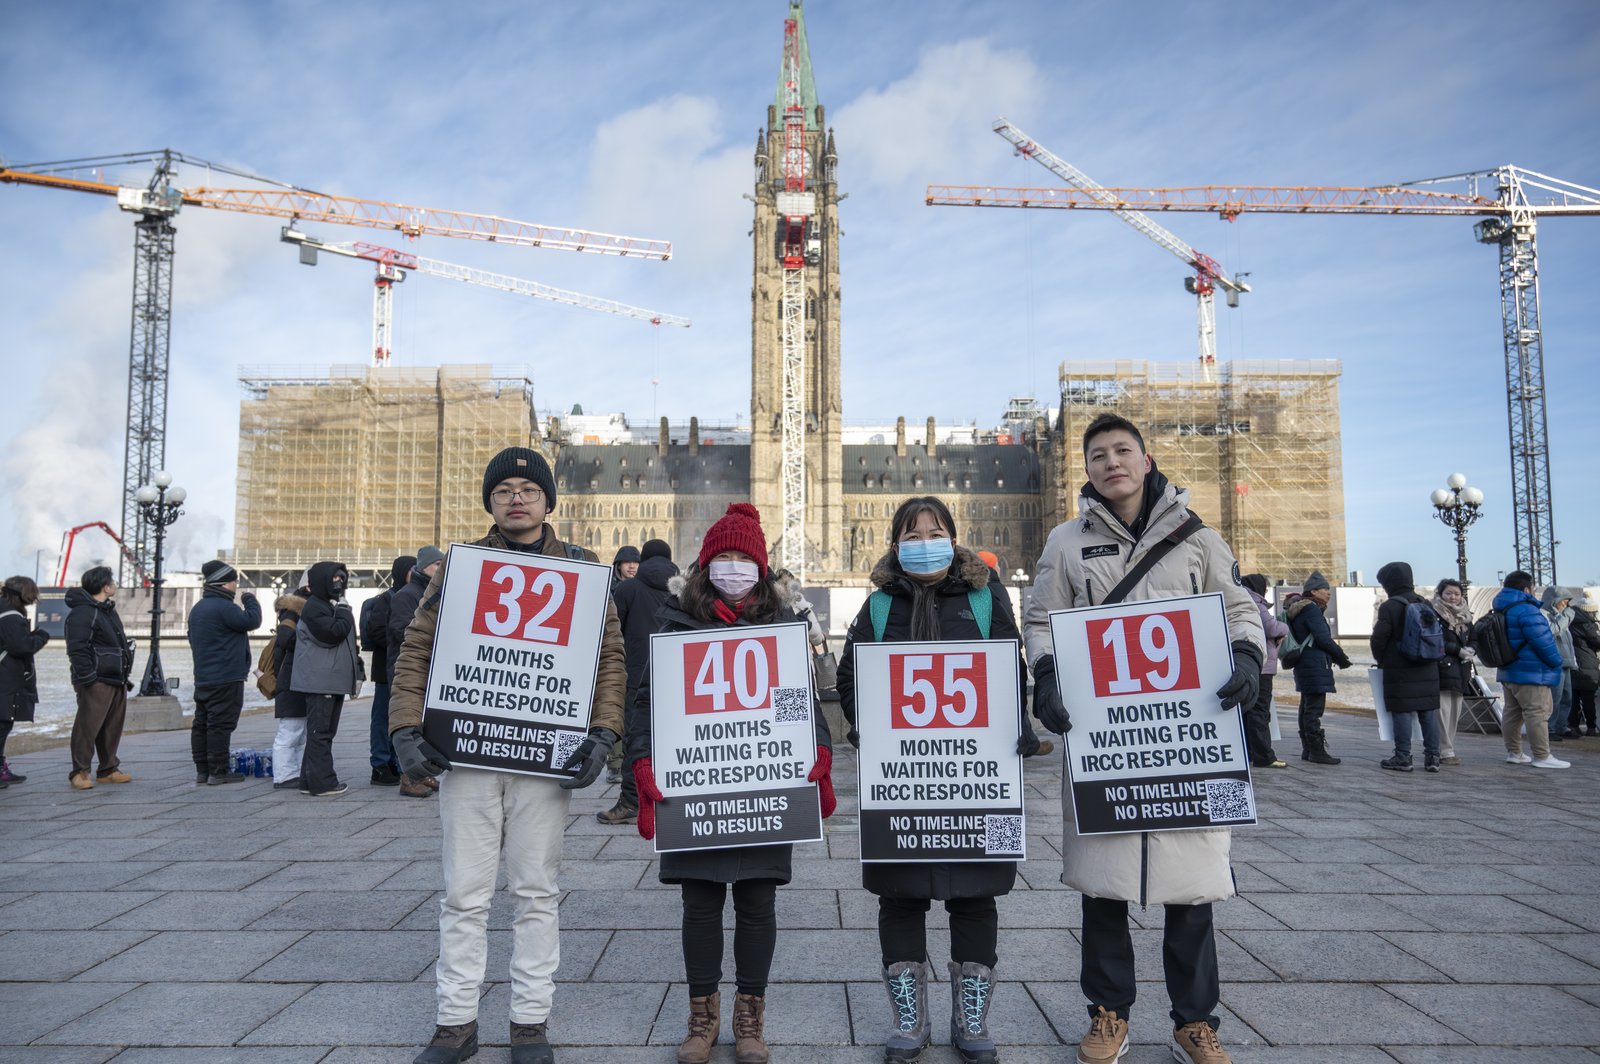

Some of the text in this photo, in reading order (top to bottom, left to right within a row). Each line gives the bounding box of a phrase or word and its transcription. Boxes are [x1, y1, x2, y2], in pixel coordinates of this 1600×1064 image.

[485, 565, 566, 642] 32
[477, 645, 555, 670] MONTHS
[1102, 614, 1180, 693] 19
[455, 664, 571, 695] WAITING FOR
[694, 639, 769, 711] 40
[439, 685, 579, 718] IRCC RESPONSE
[901, 654, 977, 726] 55
[1108, 701, 1191, 724] MONTHS
[453, 719, 555, 744] NO TIMELINES
[695, 720, 771, 741] MONTHS
[1089, 722, 1218, 748] WAITING FOR
[456, 738, 546, 762] NO RESULTS
[676, 740, 793, 765] WAITING FOR
[900, 739, 978, 756] MONTHS
[1081, 745, 1233, 772] IRCC RESPONSE
[665, 762, 805, 788] IRCC RESPONSE
[881, 761, 998, 778] WAITING FOR
[871, 783, 1010, 801] IRCC RESPONSE
[1105, 781, 1205, 801] NO TIMELINE
[685, 796, 788, 818] NO TIMELINES
[1114, 800, 1210, 820] NO RESULTS
[692, 816, 782, 836] NO RESULTS
[890, 816, 910, 831] NO
[897, 834, 986, 849] NO RESULTS
